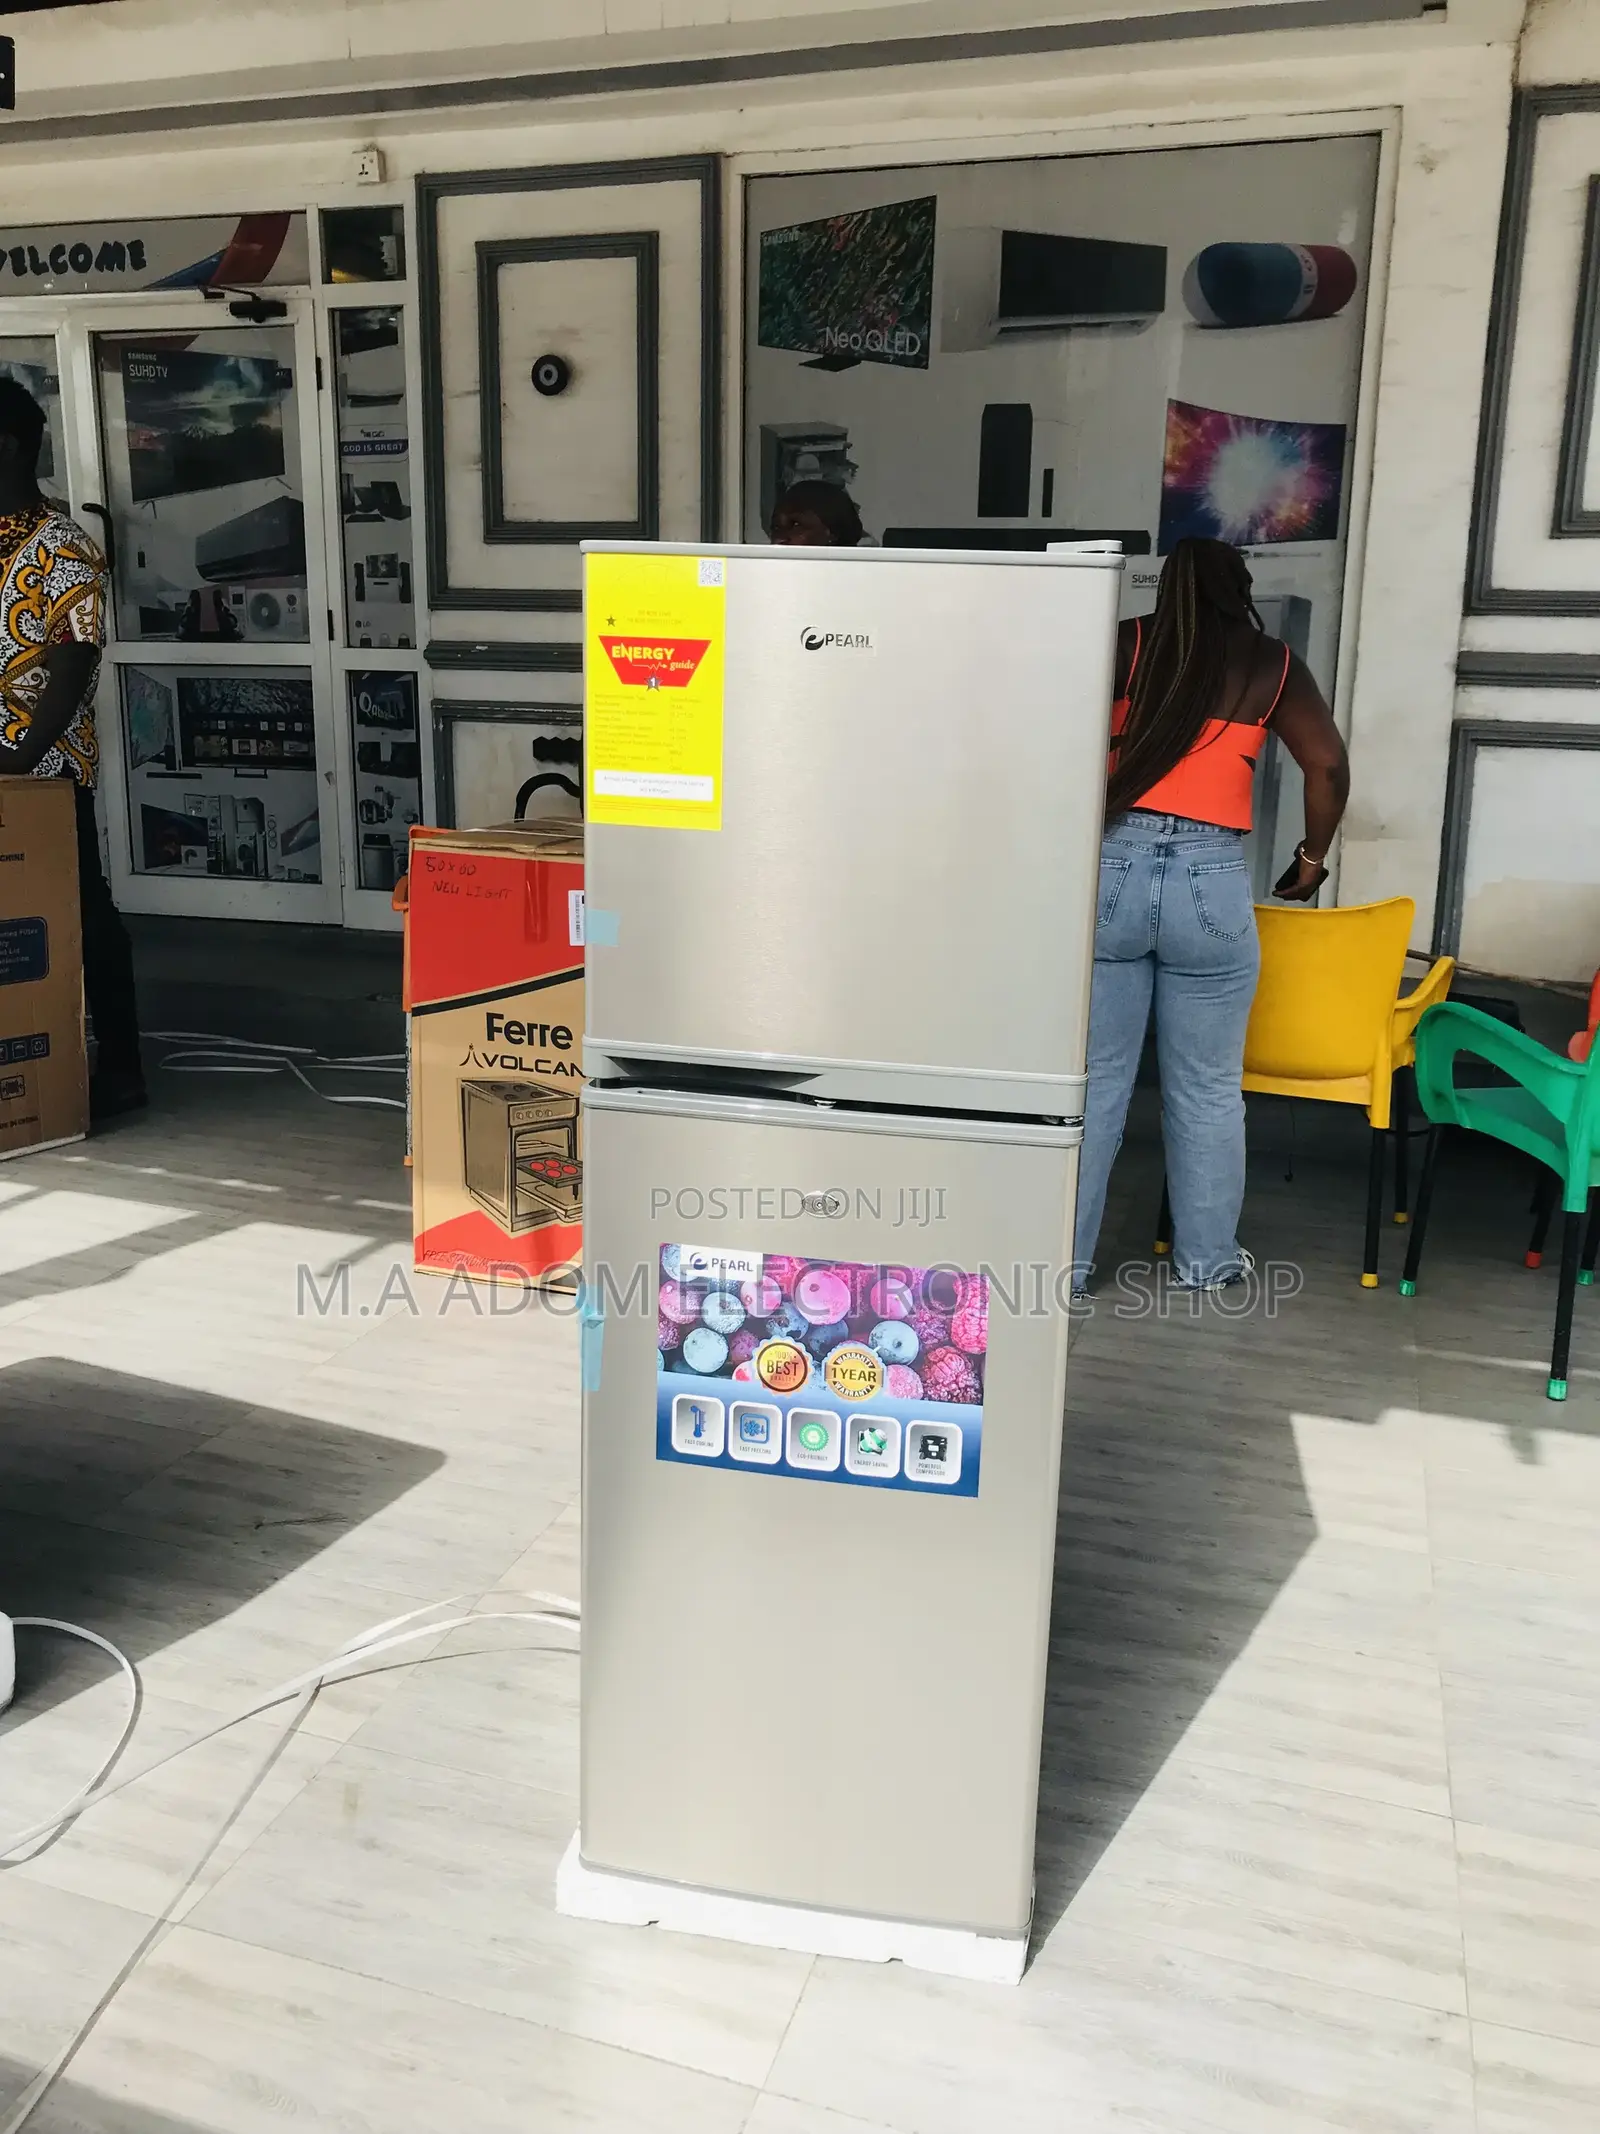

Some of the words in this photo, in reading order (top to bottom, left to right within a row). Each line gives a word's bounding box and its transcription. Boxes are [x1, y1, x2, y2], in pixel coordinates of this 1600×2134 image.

[825, 326, 862, 349] Neo
[866, 328, 921, 356] QLED
[363, 444, 371, 452] IS
[375, 443, 403, 451] GREAT
[1132, 574, 1158, 584] SUHD
[825, 633, 873, 648] PEARL
[611, 642, 675, 663] ENERGY
[669, 660, 696, 671] guide
[486, 1012, 573, 1050] Ferre
[711, 1258, 754, 1272] PEARL
[767, 1359, 799, 1376] BEST
[834, 1352, 875, 1368] WARRANTY
[840, 1368, 877, 1382] YEAR
[834, 1382, 873, 1397] WARRANTY
